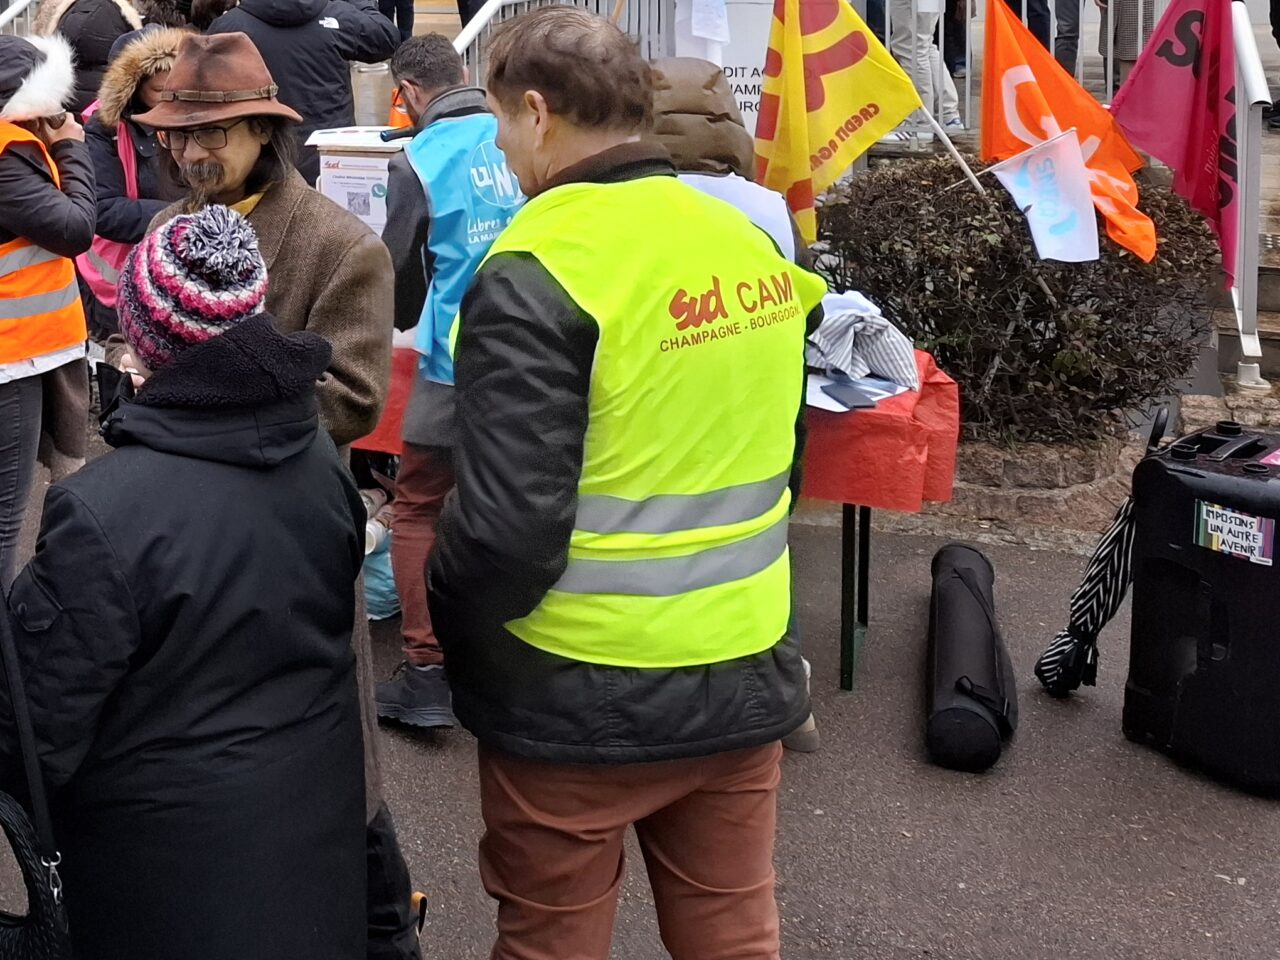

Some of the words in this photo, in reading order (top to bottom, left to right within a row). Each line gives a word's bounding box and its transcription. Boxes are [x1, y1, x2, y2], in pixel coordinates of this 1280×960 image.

[669, 275, 729, 331] Sud
[736, 271, 793, 313] CAM
[660, 321, 742, 353] CHAMPAGNE
[1210, 524, 1224, 535] UN
[1227, 527, 1259, 544] AUTRE
[1220, 538, 1257, 558] AVENIR
